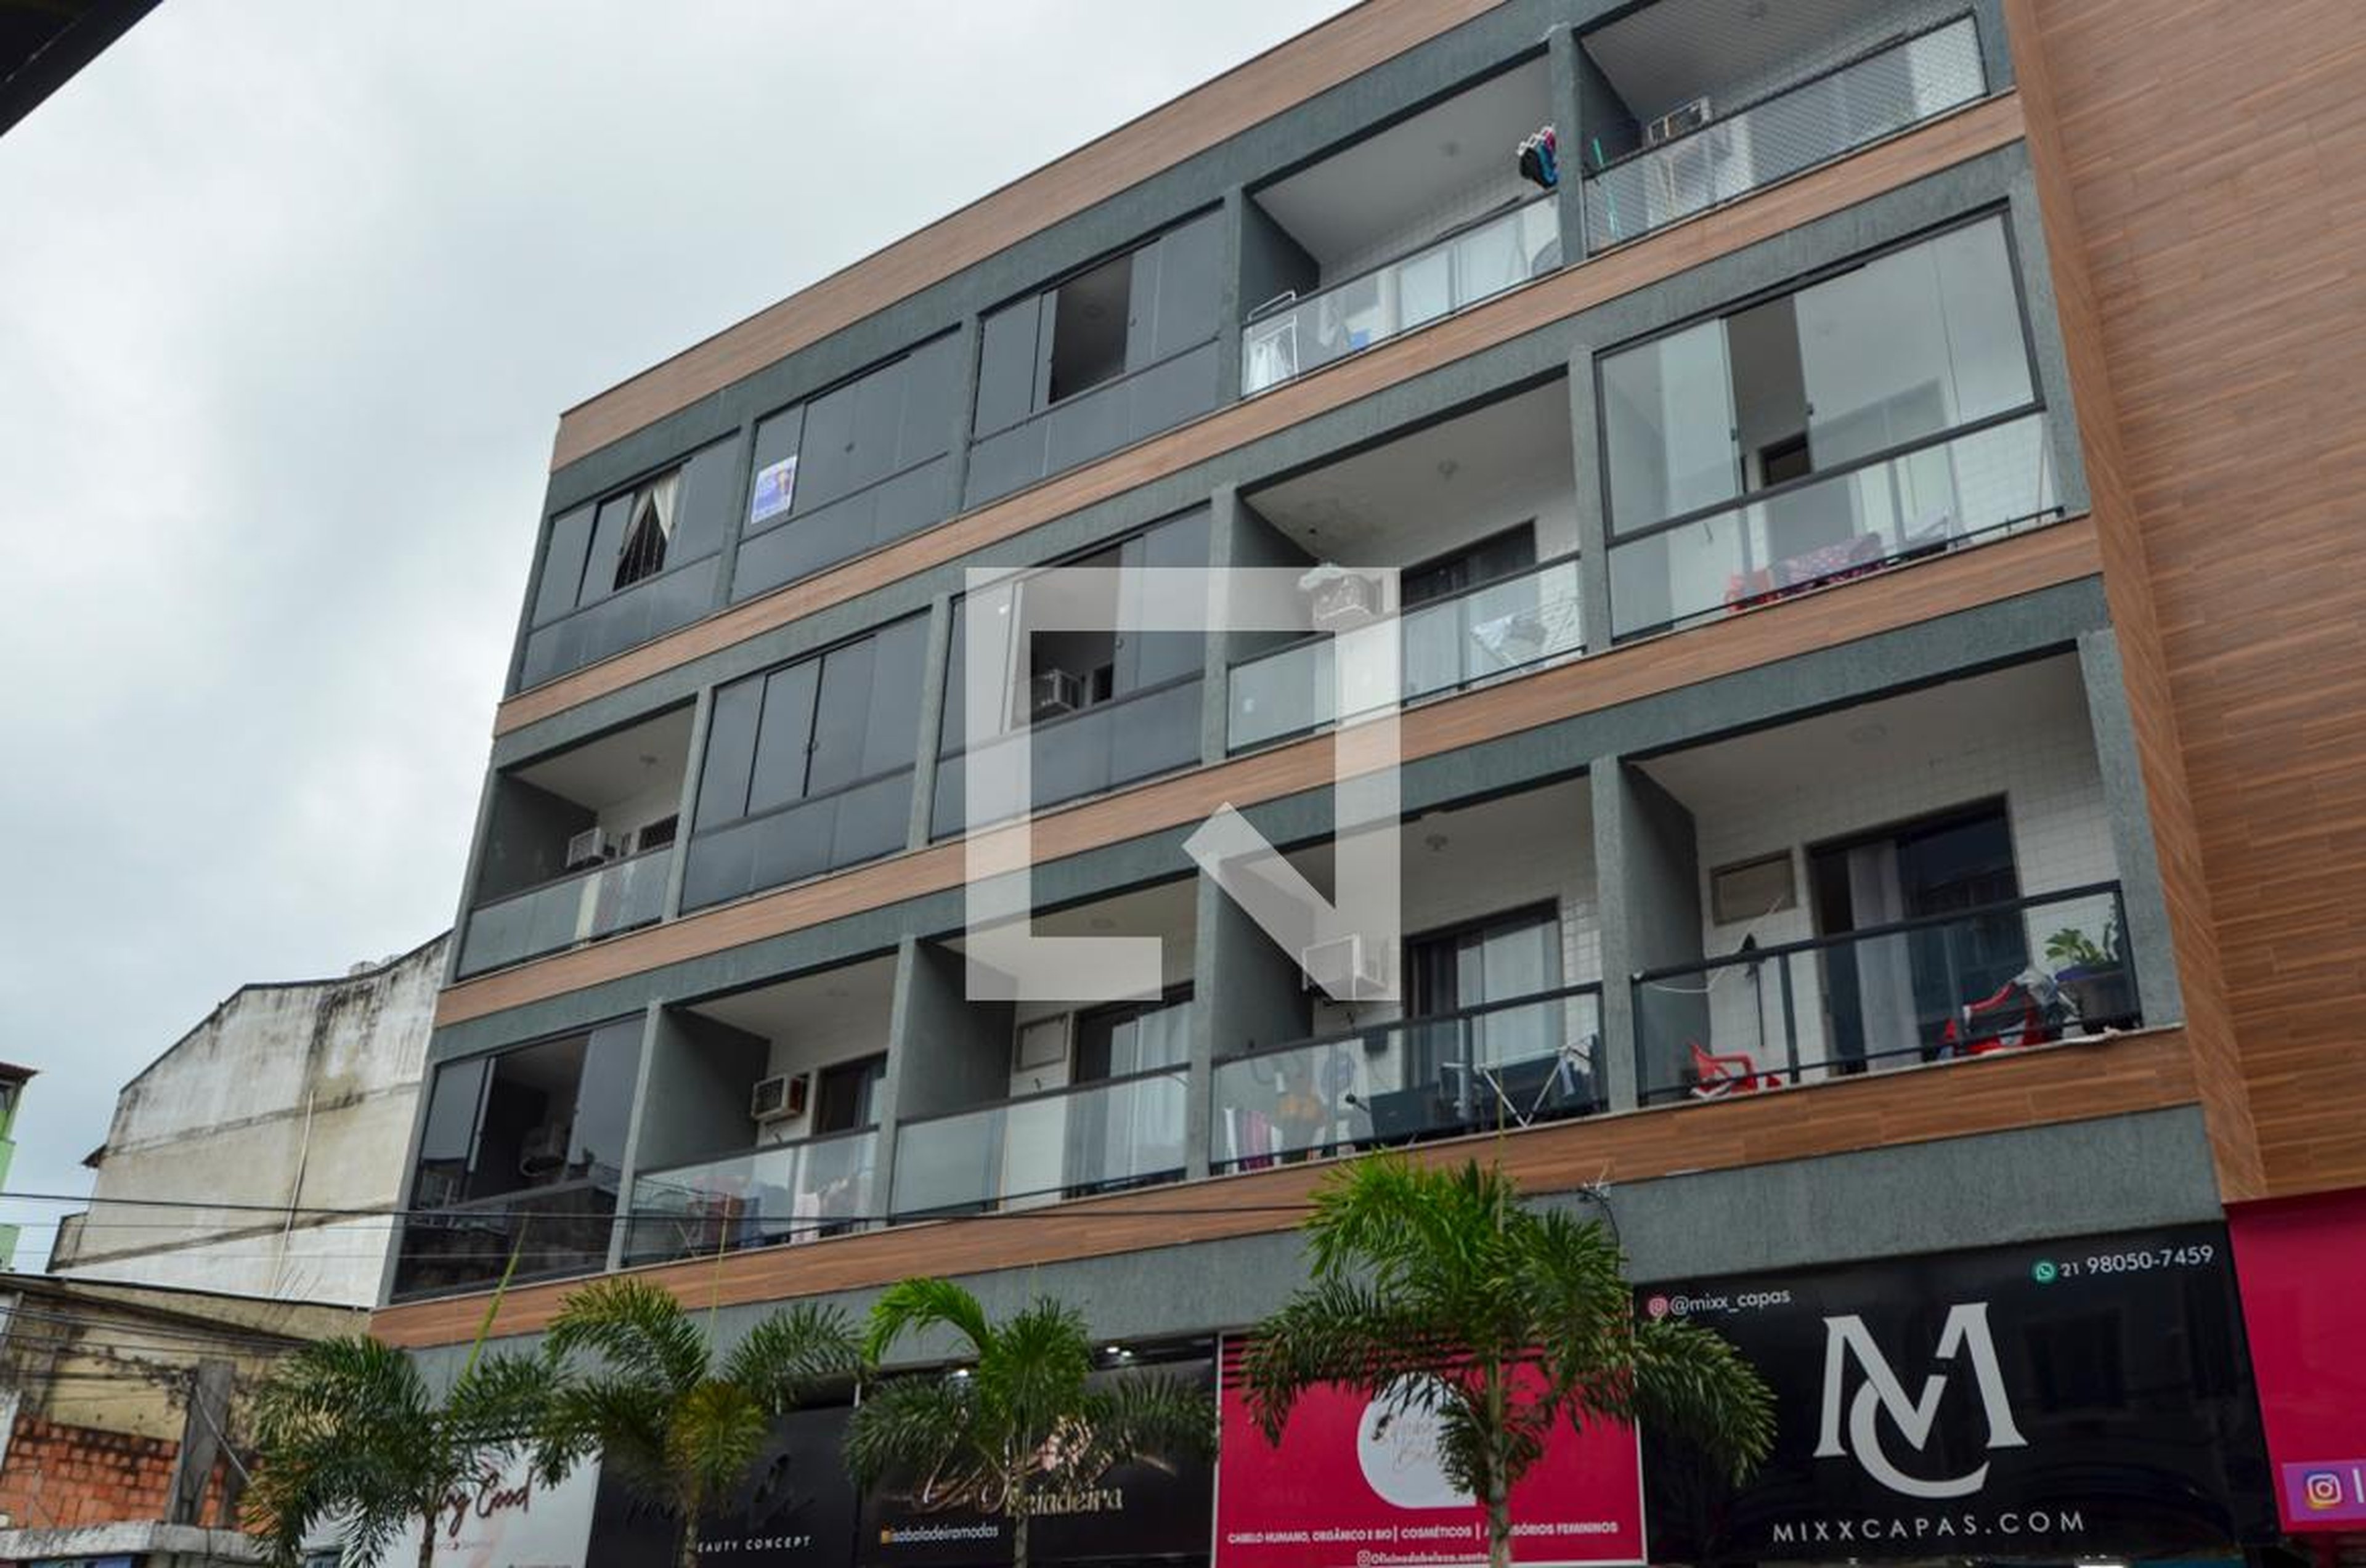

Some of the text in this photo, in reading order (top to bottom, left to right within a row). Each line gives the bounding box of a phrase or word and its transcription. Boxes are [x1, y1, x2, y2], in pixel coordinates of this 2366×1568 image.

[2060, 1245, 2214, 1277] 21 98050-7459
[1670, 1290, 1791, 1316] @mixx_capas
[1400, 1525, 1472, 1538] COSMÉTICOS
[1773, 1511, 2084, 1542] MIXXCAPAS.COM
[697, 1535, 810, 1553] EAUTY CONCEPT
